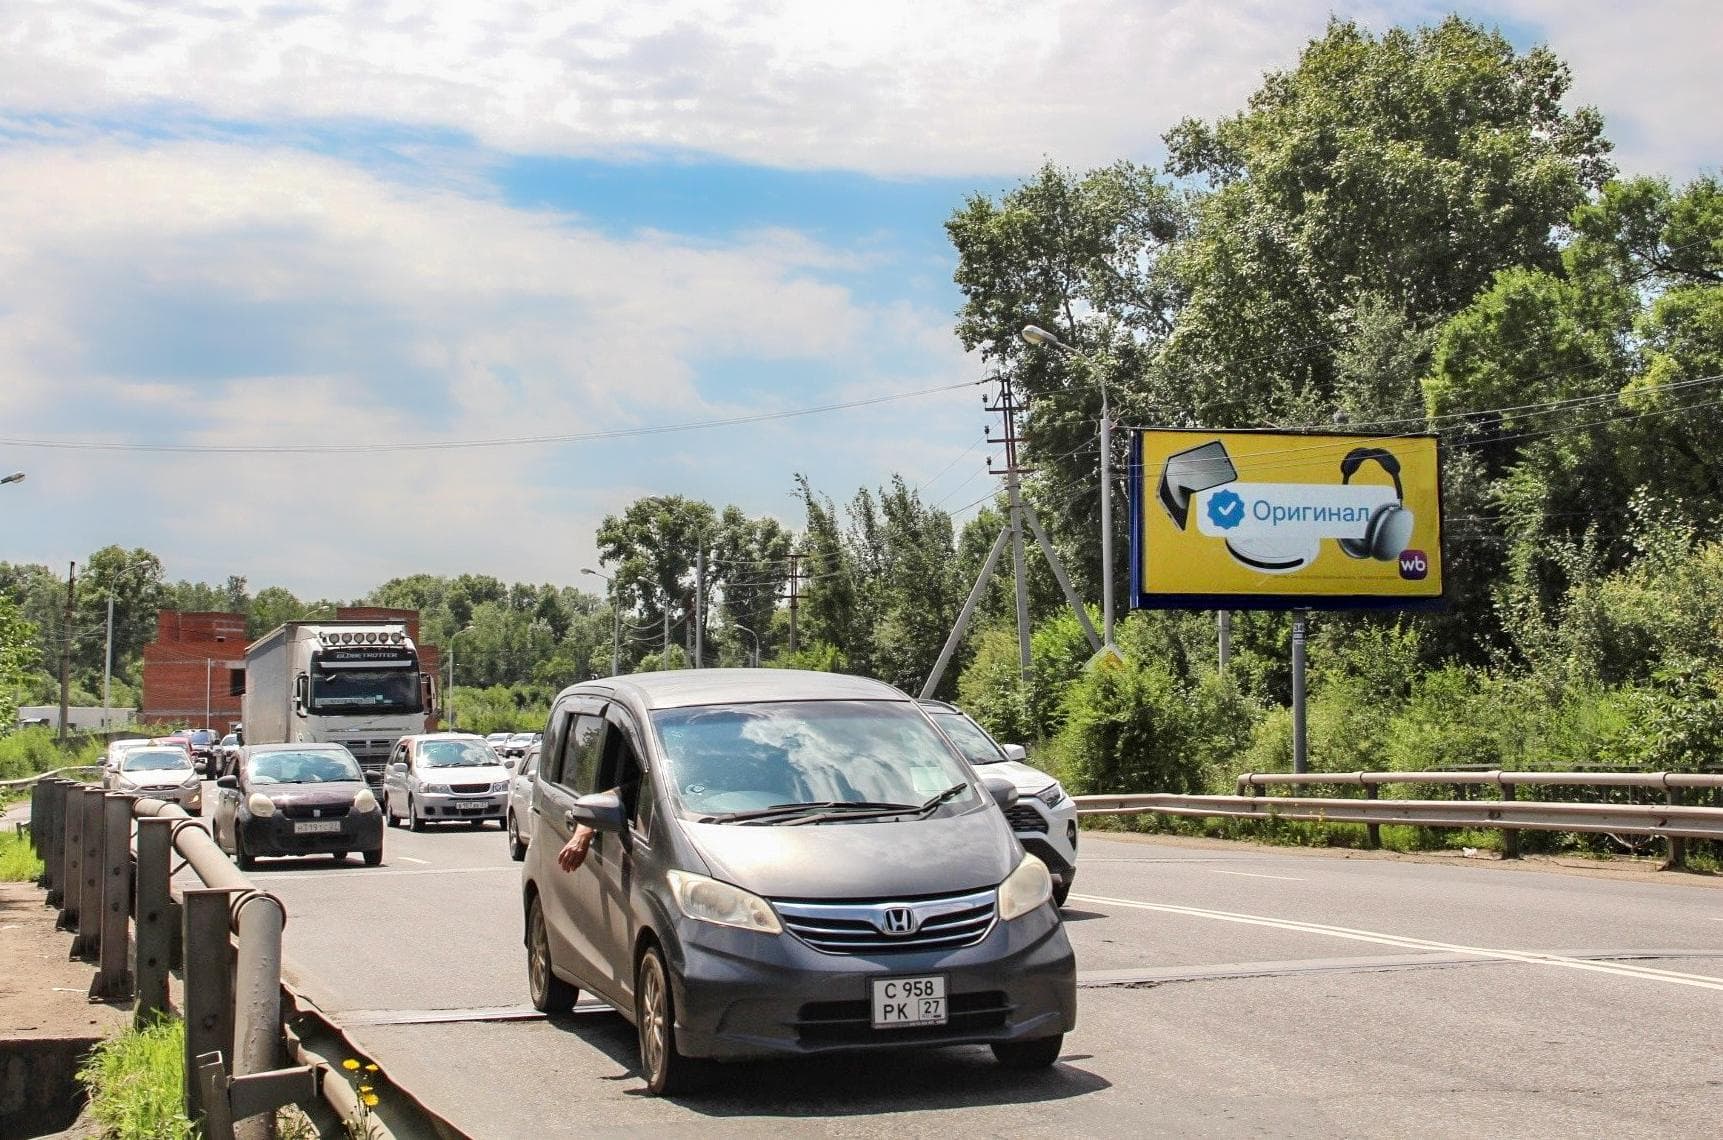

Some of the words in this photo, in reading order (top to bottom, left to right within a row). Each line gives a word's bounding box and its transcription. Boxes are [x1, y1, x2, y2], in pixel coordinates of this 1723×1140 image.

[1253, 500, 1370, 526] Оригинал
[1400, 555, 1427, 572] wb
[902, 980, 934, 998] 958
[883, 1002, 909, 1021] РК
[923, 1000, 940, 1014] 27
